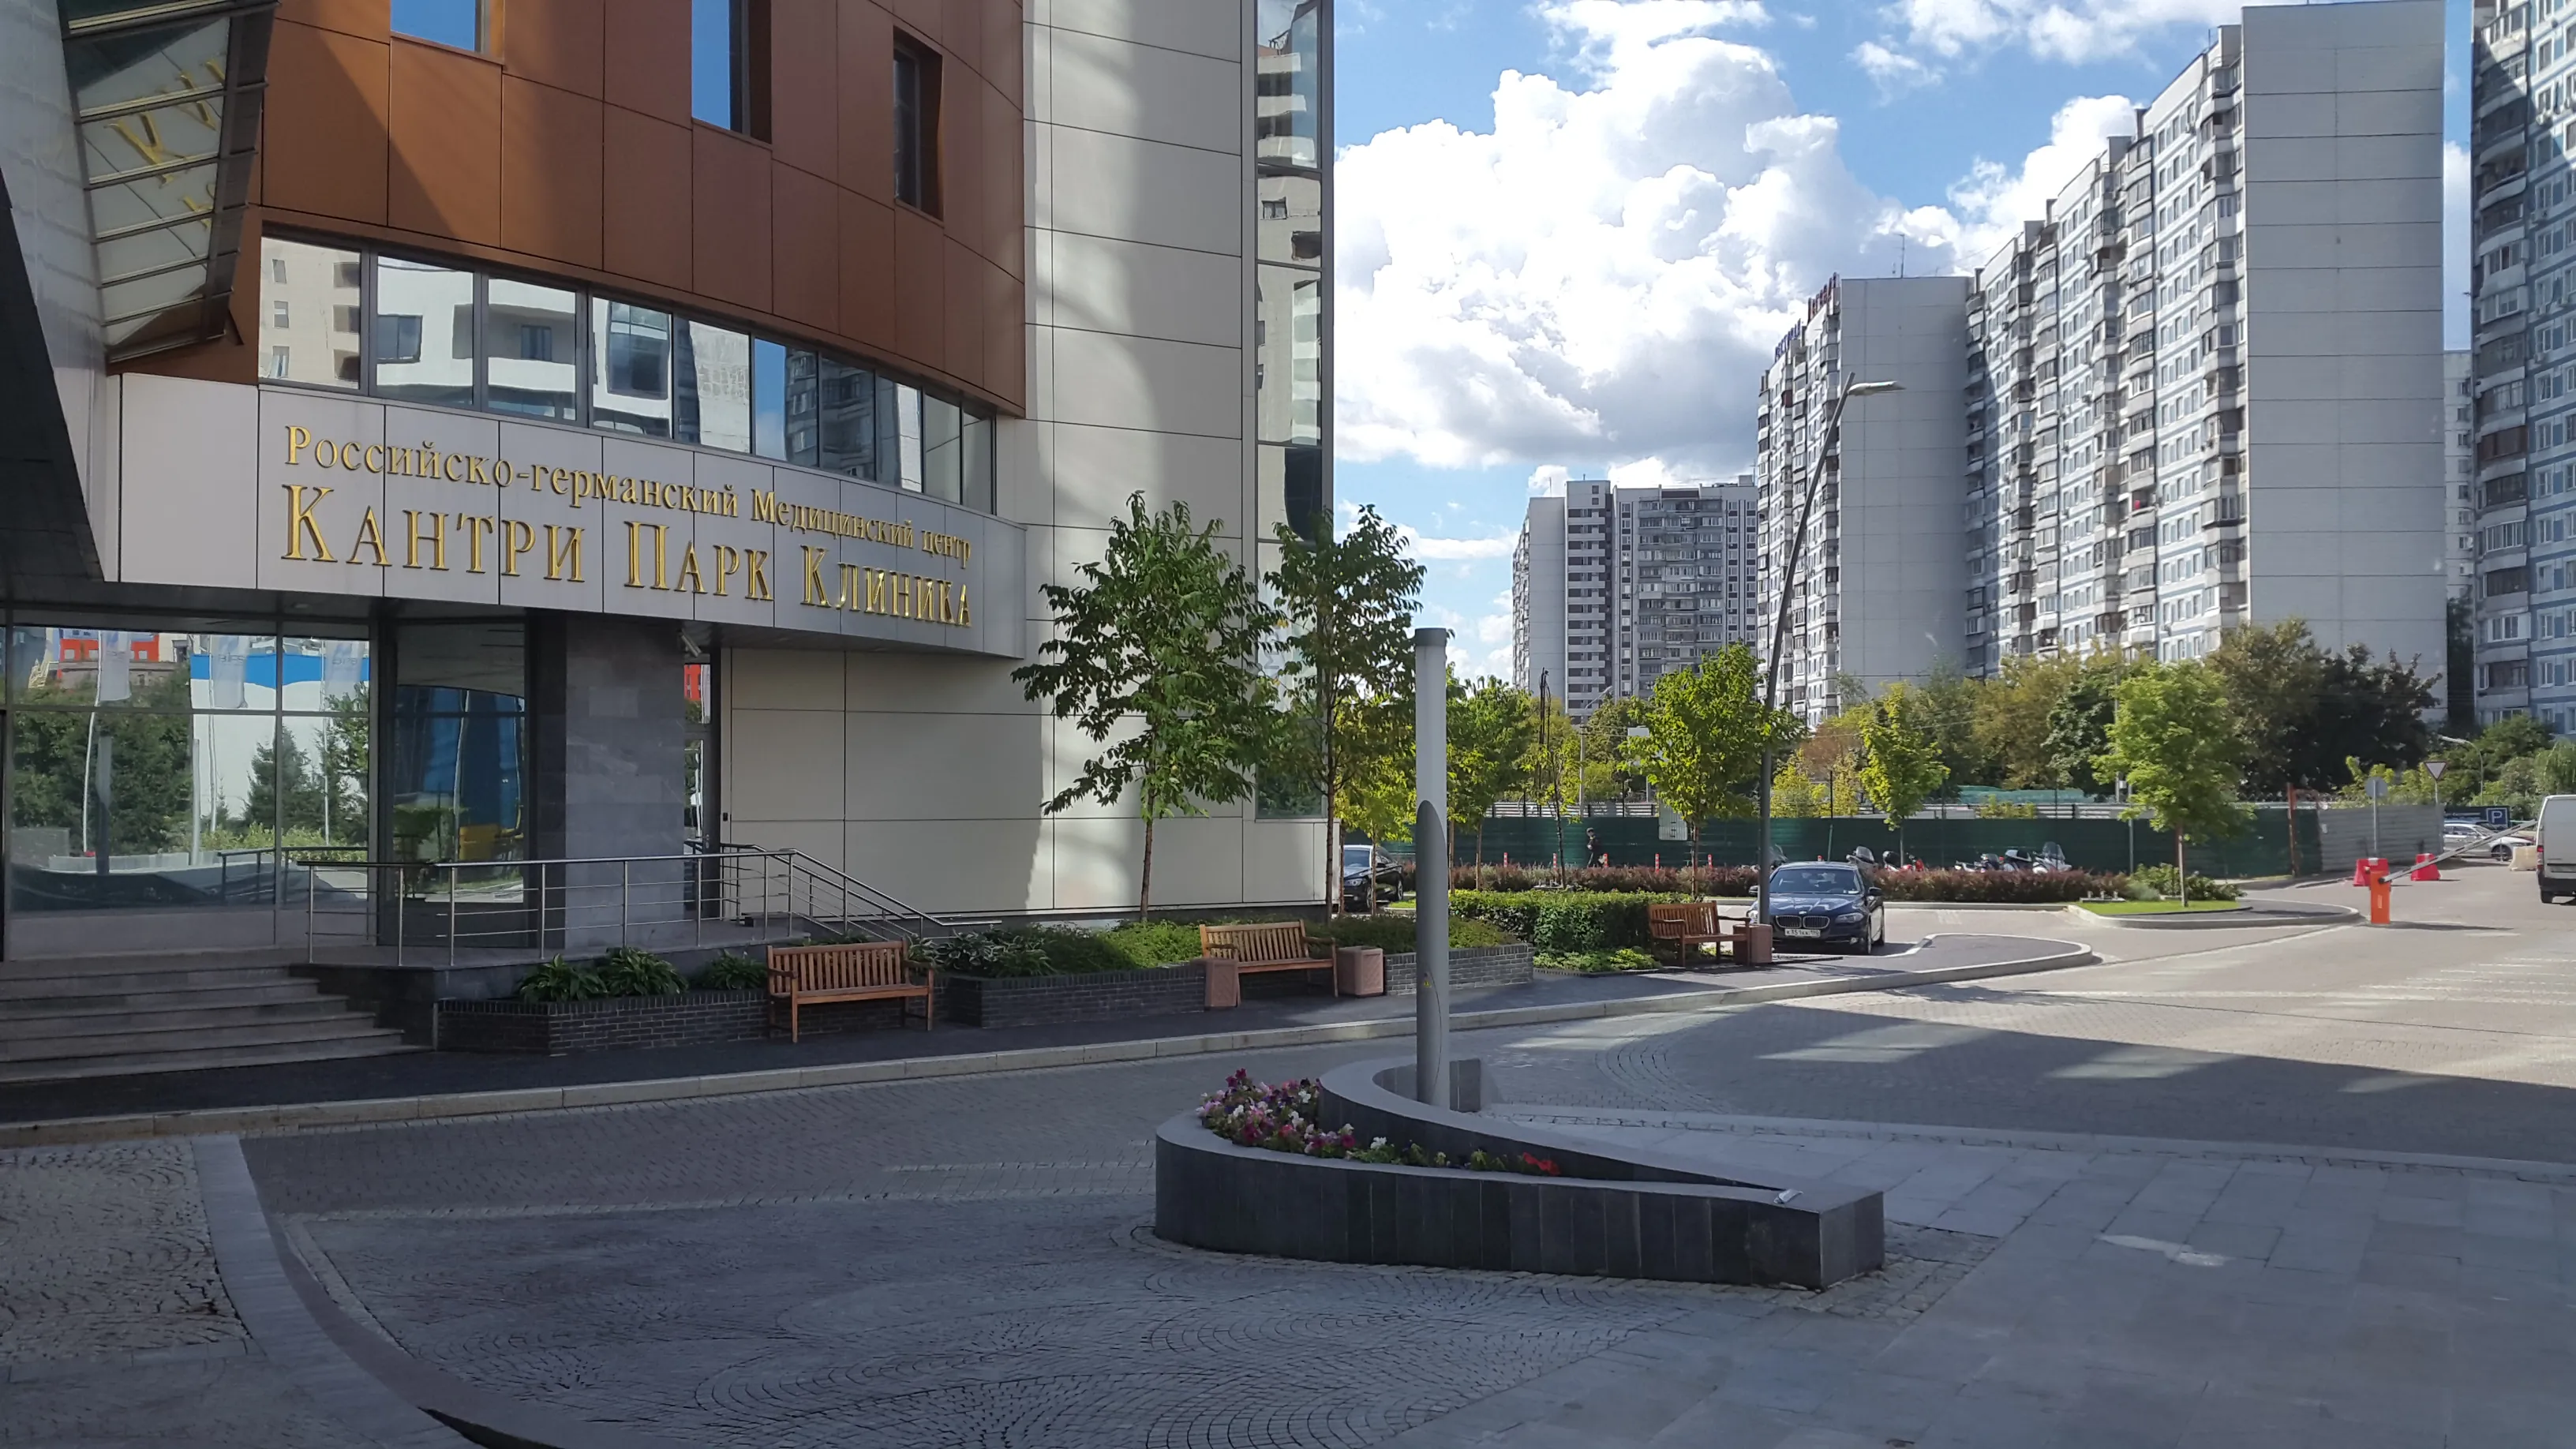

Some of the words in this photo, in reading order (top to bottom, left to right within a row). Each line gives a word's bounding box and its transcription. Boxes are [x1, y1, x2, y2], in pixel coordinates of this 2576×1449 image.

[281, 483, 586, 583] КАНТРИ
[623, 520, 775, 601] ПАРК
[799, 545, 972, 628] КЛИНИКА
[285, 425, 739, 519] Российско-германский
[751, 488, 914, 549] Медицинский
[922, 529, 972, 569] центр
[2492, 810, 2503, 824] P
